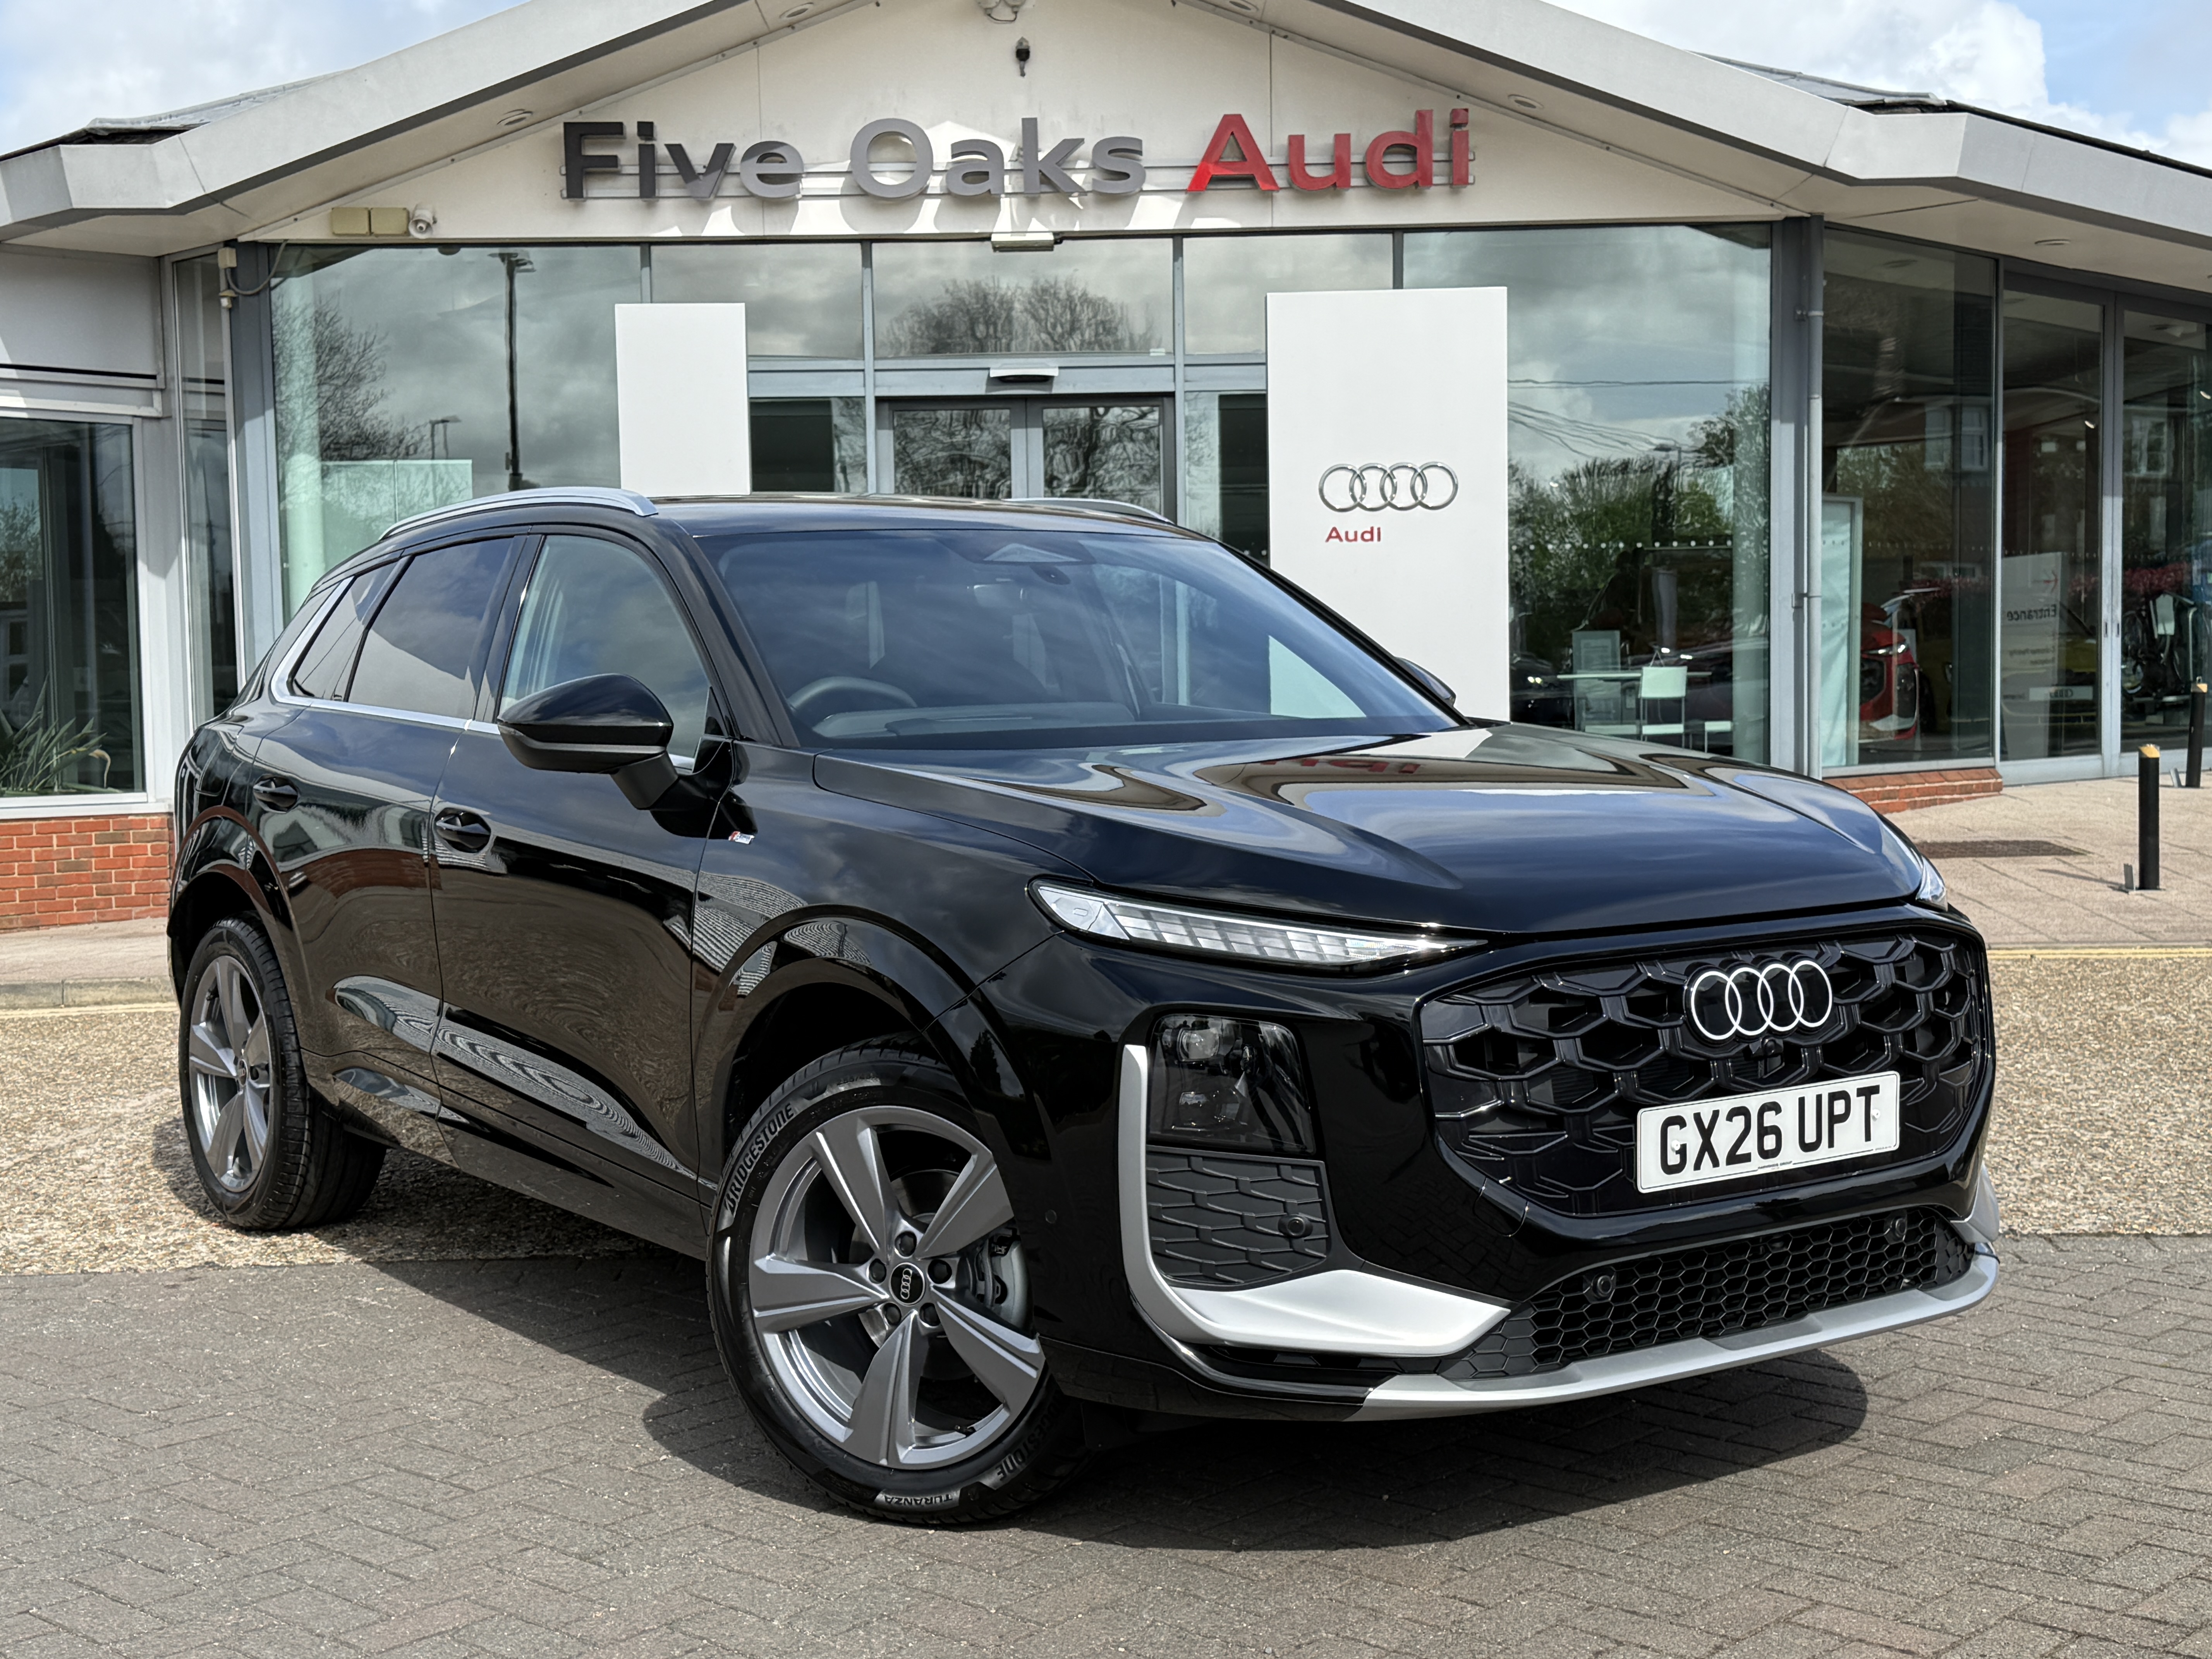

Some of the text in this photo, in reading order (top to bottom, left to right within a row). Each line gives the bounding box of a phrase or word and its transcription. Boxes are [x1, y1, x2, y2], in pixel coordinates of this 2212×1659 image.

[563, 108, 1469, 199] Five Oaks Audi
[1325, 526, 1381, 542] Audi
[723, 1102, 795, 1216] BRIDGESTONE
[1660, 1084, 1881, 1176] GX26 UPT
[884, 1494, 953, 1506] TURANZA
